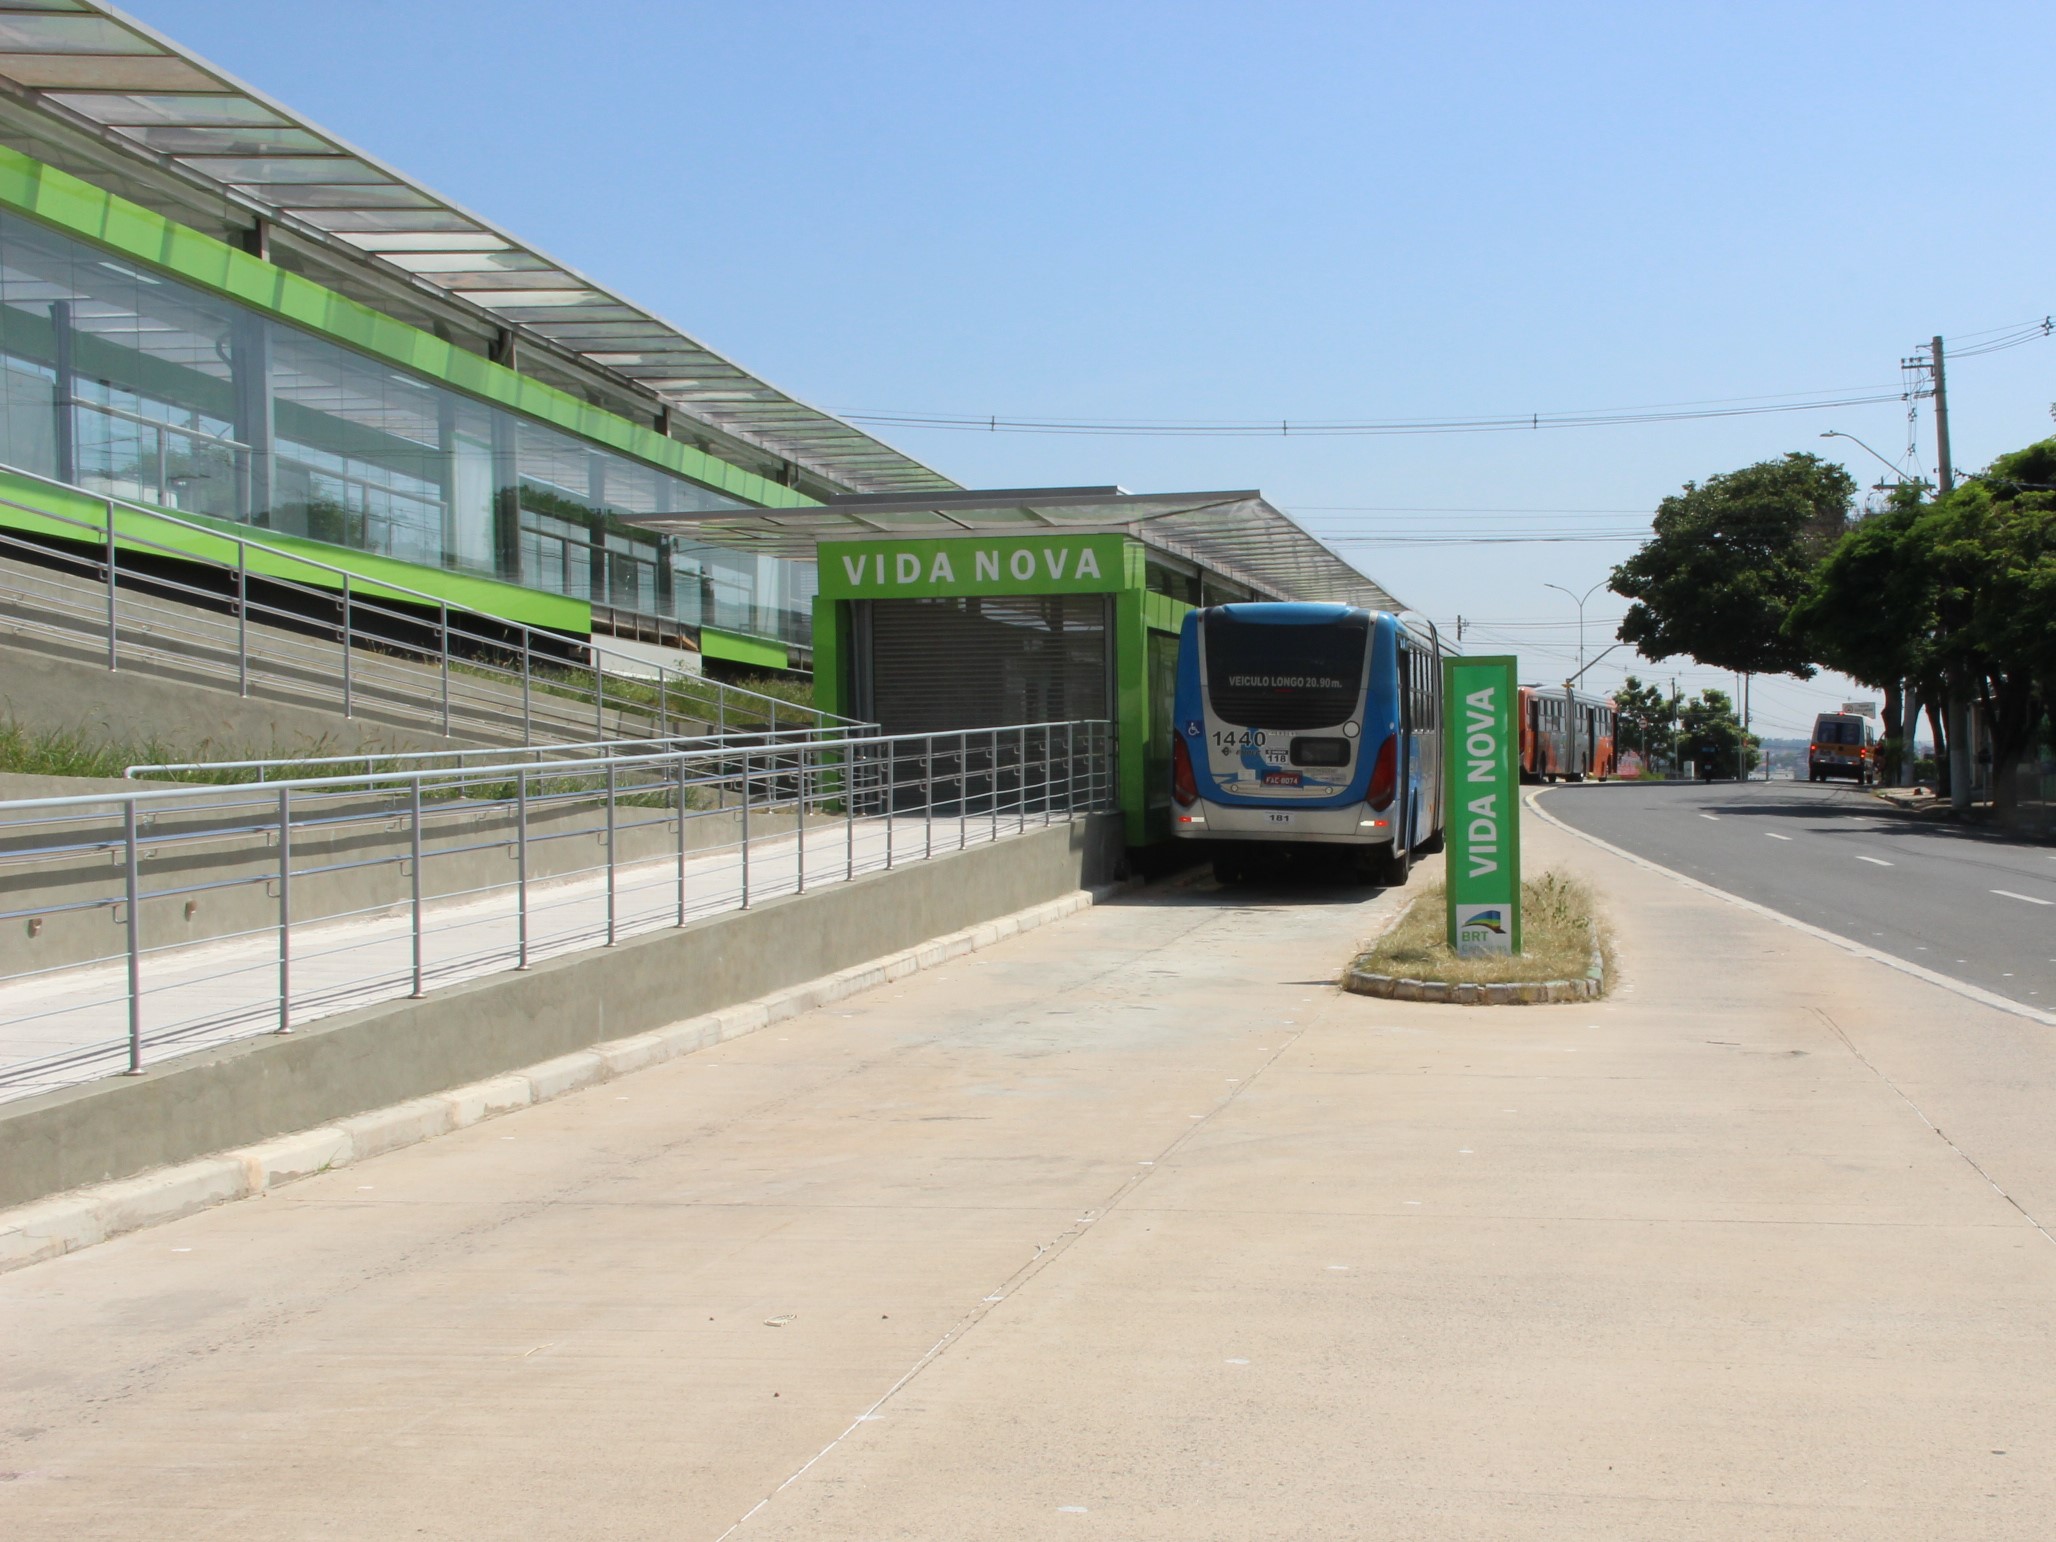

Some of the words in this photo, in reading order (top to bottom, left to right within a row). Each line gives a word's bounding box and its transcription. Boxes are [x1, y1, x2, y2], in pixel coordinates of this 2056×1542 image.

[842, 552, 955, 586] VIDA
[975, 548, 1101, 582] NOVA
[1271, 676, 1304, 688] LONGO
[1212, 731, 1266, 747] 1440
[1466, 687, 1496, 783] NOVA
[1267, 755, 1286, 763] 118
[1269, 814, 1290, 822] 181
[1467, 794, 1497, 878] VIDA
[1462, 930, 1488, 942] BRT
